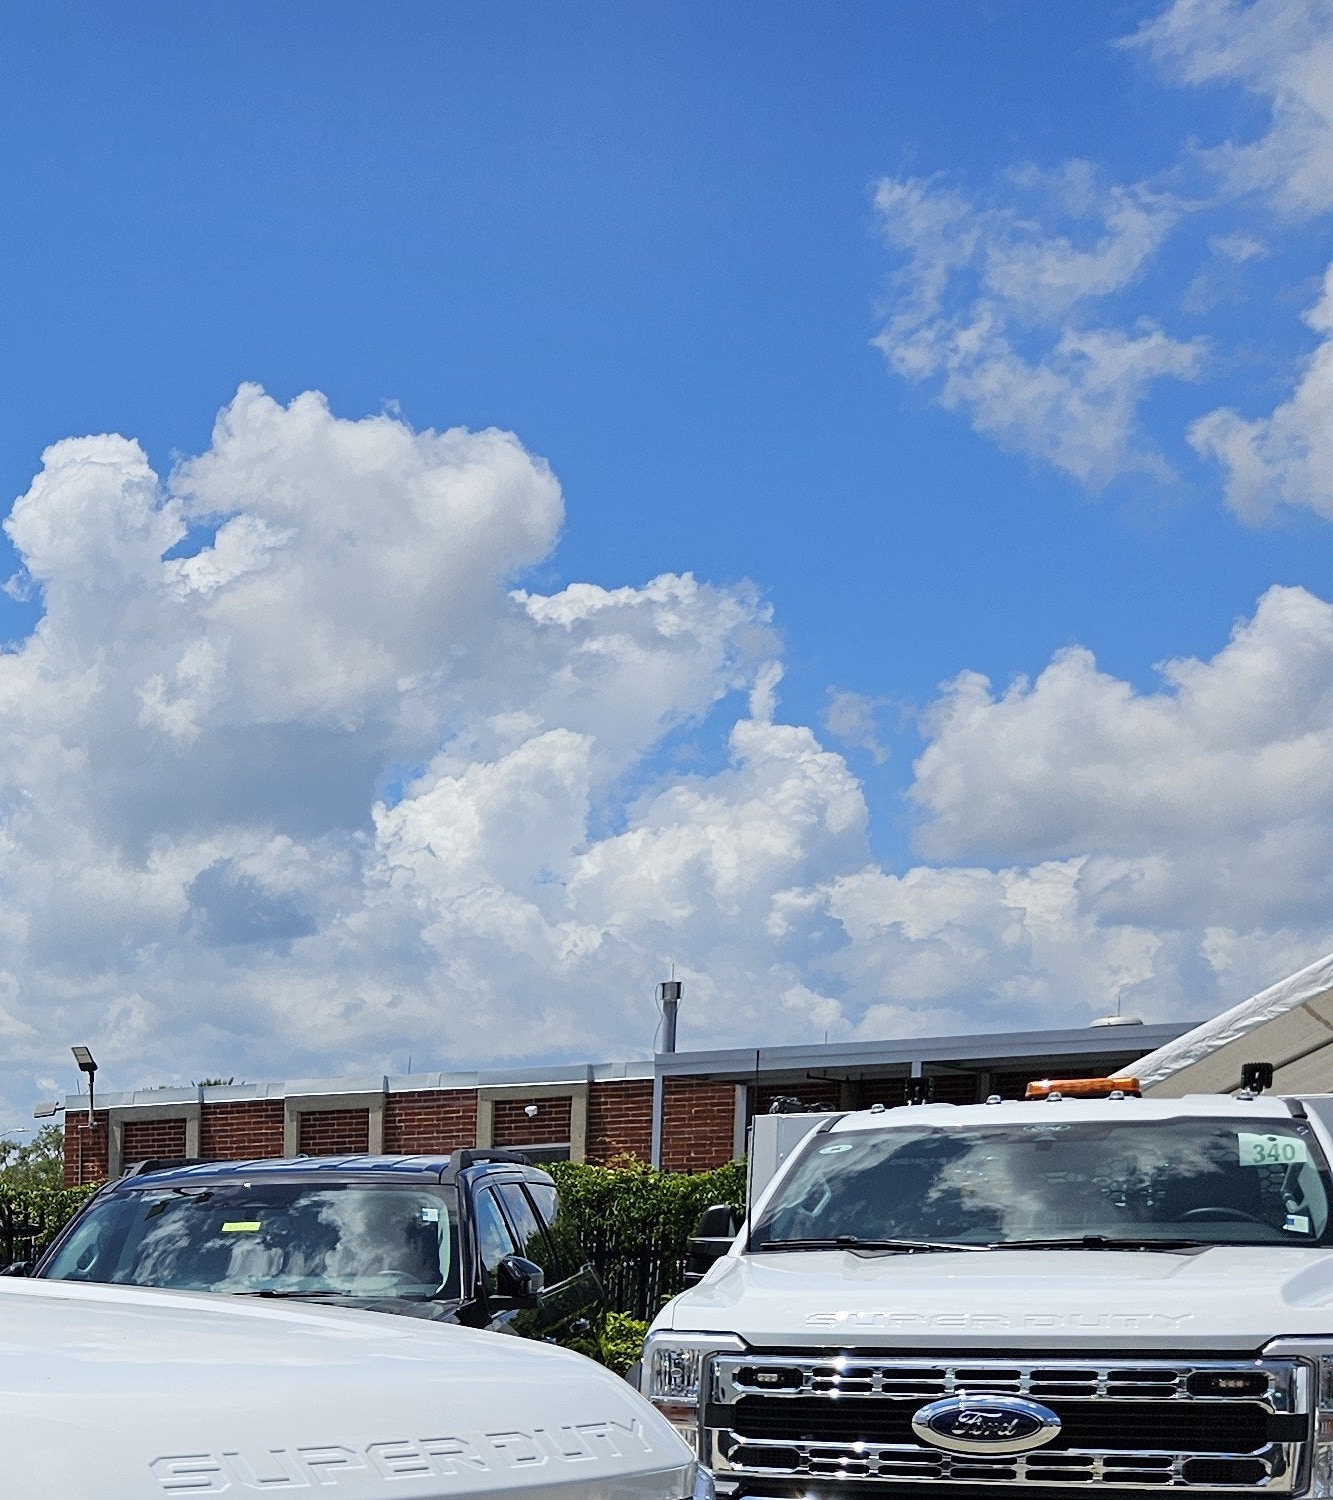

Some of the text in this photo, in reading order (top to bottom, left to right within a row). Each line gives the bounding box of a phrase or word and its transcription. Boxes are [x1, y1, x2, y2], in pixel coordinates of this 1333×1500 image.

[1252, 1143, 1296, 1164] 340
[804, 1310, 1196, 1330] SUPER DUTY
[951, 1409, 1020, 1438] Ford
[149, 1417, 655, 1497] SUPER DUTY
